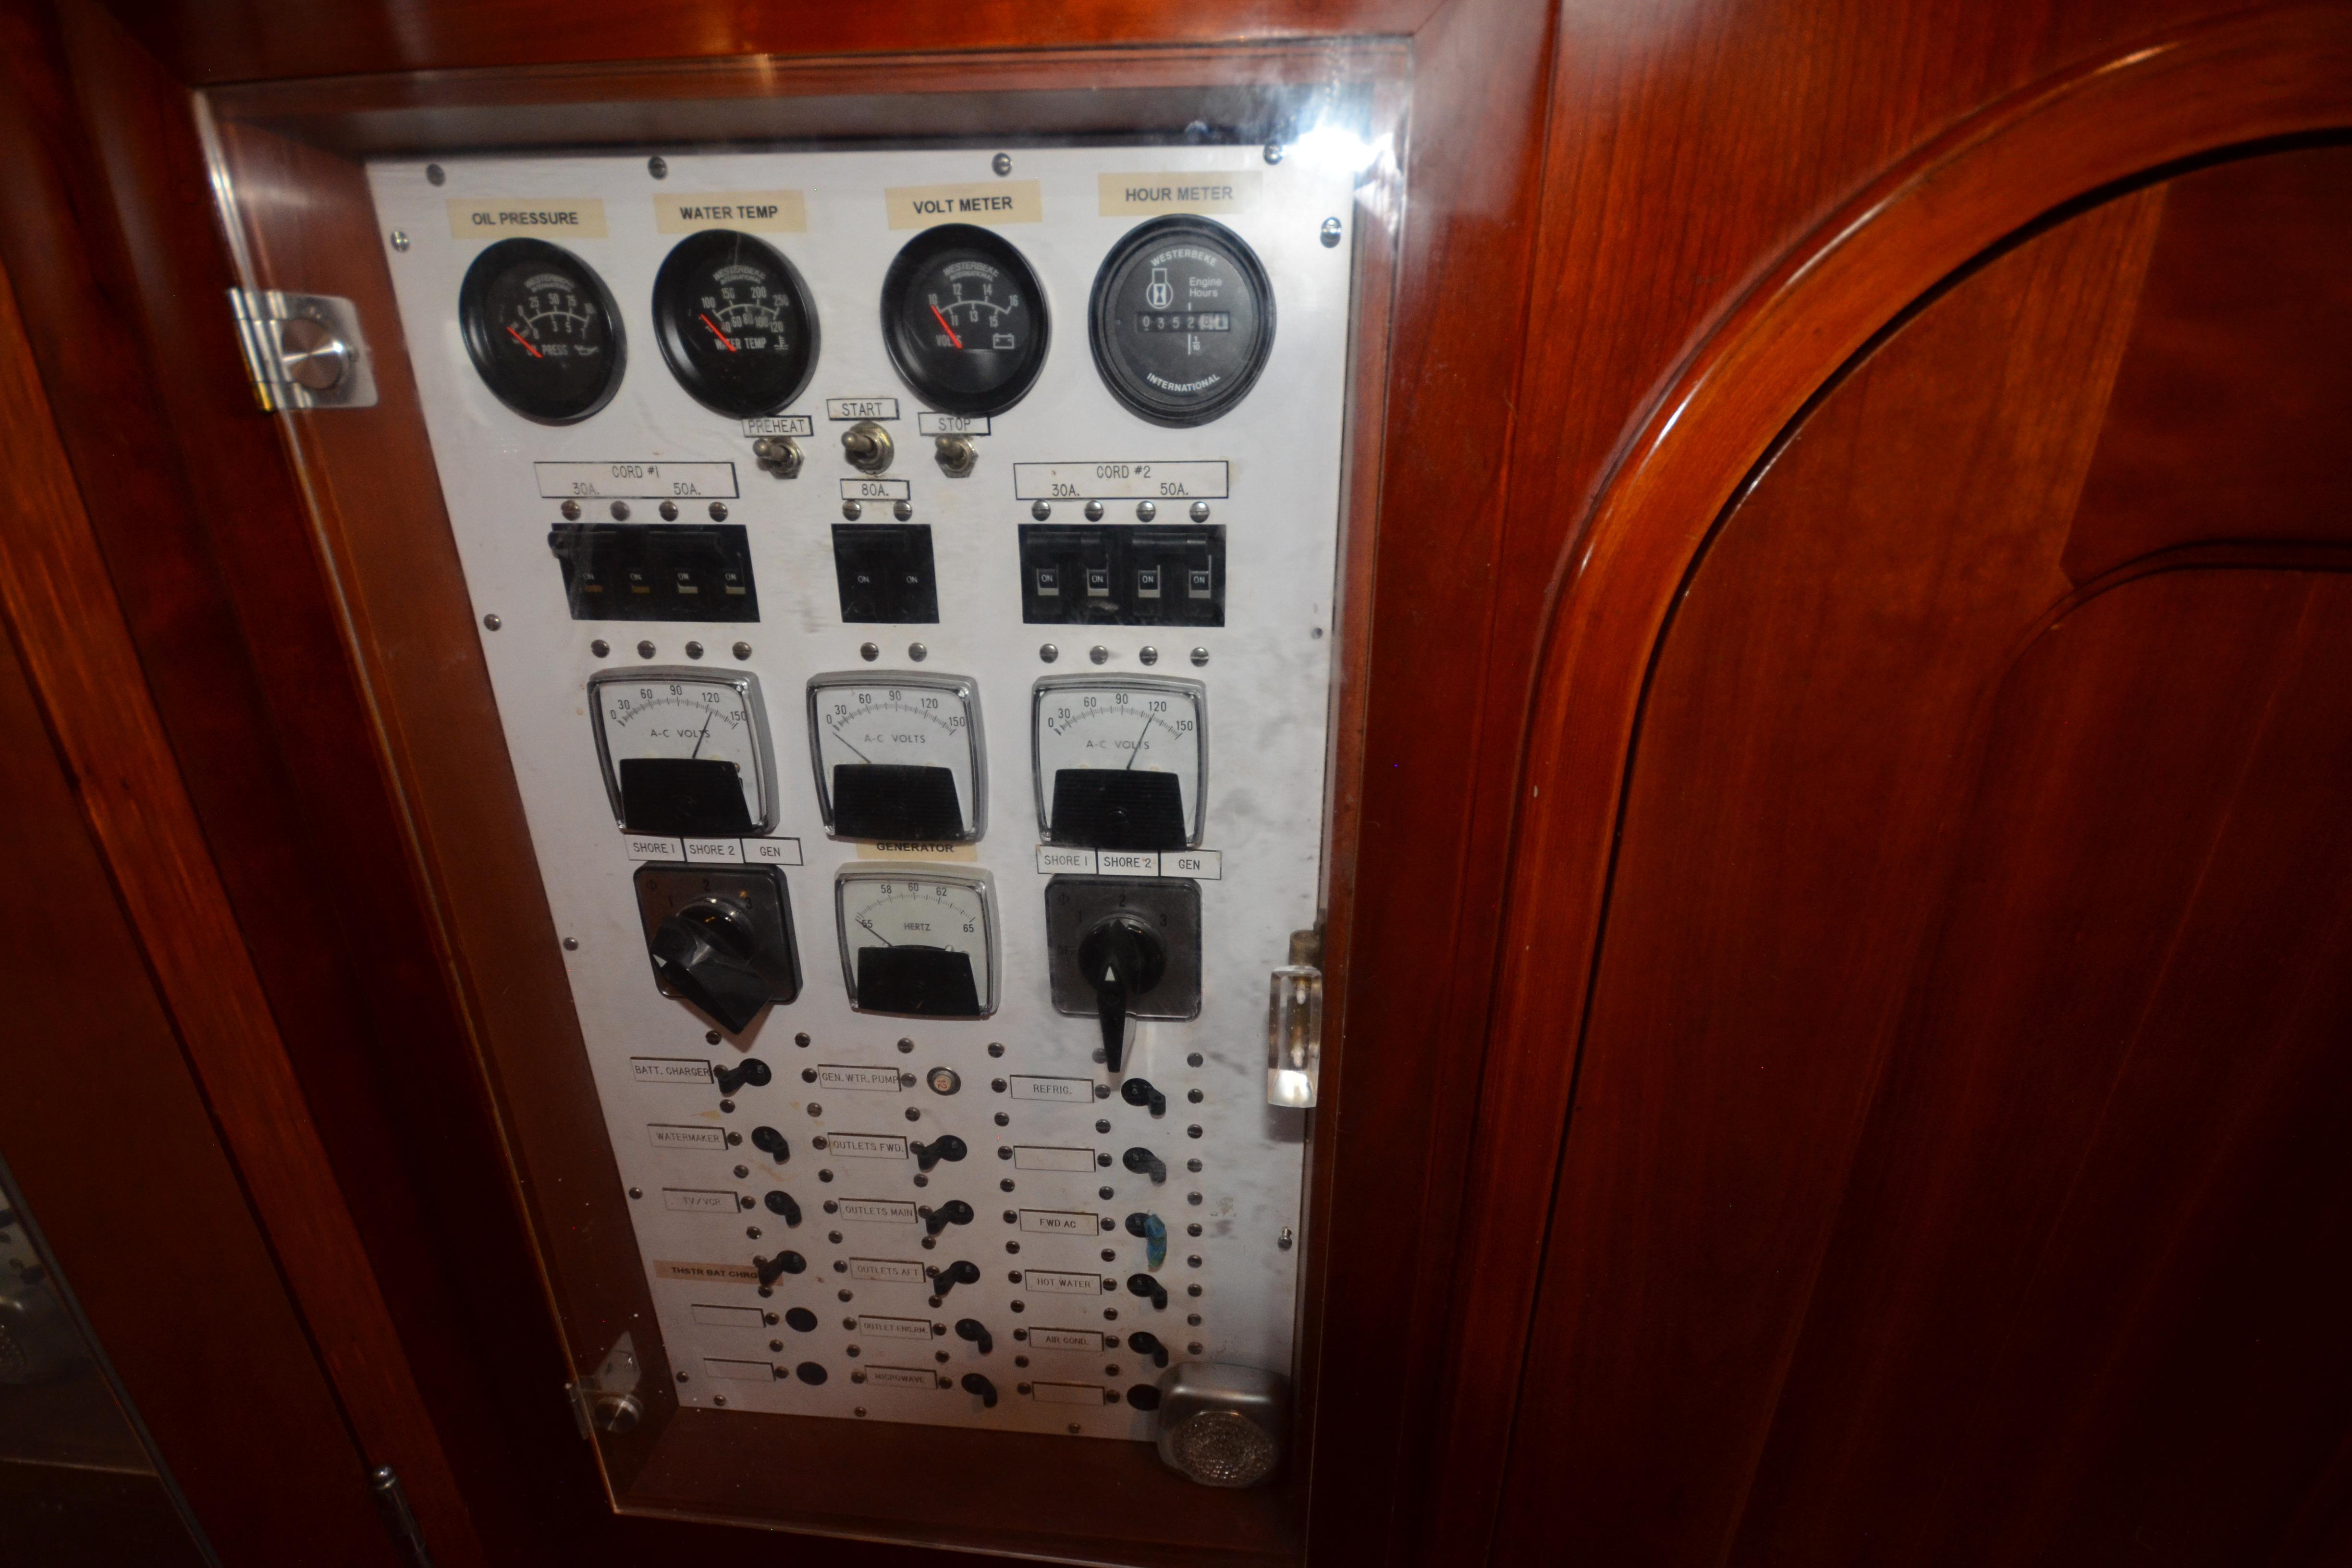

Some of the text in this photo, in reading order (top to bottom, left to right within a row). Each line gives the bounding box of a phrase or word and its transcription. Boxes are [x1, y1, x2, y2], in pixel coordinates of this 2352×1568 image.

[1125, 185, 1233, 202] HOUR METER
[913, 196, 1013, 215] VOLT METER
[680, 205, 778, 220] WATER TEMP
[472, 212, 578, 225] OIL PRESSURE
[1151, 249, 1217, 267] WESTERBEKE
[713, 265, 766, 281] WESTERBEKE
[943, 261, 999, 277] WESTERBEKE
[1189, 277, 1223, 287] Engine
[722, 288, 735, 299] 150
[751, 286, 767, 298] 200
[953, 283, 962, 295] 12
[983, 283, 992, 295] 14
[1189, 288, 1218, 297] Hours
[529, 296, 539, 308] 25
[548, 293, 560, 305] 50
[566, 295, 576, 306] 75
[701, 296, 716, 308] 100
[772, 294, 789, 306] 250
[928, 294, 937, 305] 10
[1010, 294, 1018, 306] 16
[951, 315, 958, 326] 11
[969, 310, 978, 322] 13
[989, 316, 998, 327] 15
[731, 316, 742, 328] 60
[770, 321, 784, 332] 120
[744, 337, 766, 349] TEMP
[541, 344, 568, 355] PRESS
[1147, 373, 1220, 392] INTERNATIONAL
[842, 403, 883, 416] START
[748, 419, 805, 432] PREHEAT
[938, 417, 971, 431] STOP
[612, 466, 660, 478] CORD #1
[1097, 466, 1151, 478] CORD #2
[572, 482, 701, 495] 30A. 50A.
[862, 484, 889, 496] 80A.
[1052, 483, 1189, 497] 30A. 50A.
[640, 689, 652, 699] 60
[670, 685, 682, 696] 90
[889, 690, 901, 701] 90
[702, 693, 720, 703] 120
[859, 694, 871, 704] 60
[921, 698, 938, 709] 120
[1084, 697, 1096, 707] 60
[1115, 694, 1128, 704] 90
[618, 699, 630, 710] 30
[835, 705, 847, 715] 30
[1149, 701, 1167, 712] 120
[610, 710, 617, 720] 0
[730, 710, 747, 721] 150
[826, 714, 832, 724] 0
[1058, 708, 1070, 719] 30
[949, 717, 966, 727] 150
[1048, 717, 1054, 728] 0
[1176, 721, 1193, 731] 150
[650, 729, 710, 738] A-C VOLTS
[864, 735, 926, 743] A-C VOLTS
[1086, 740, 1150, 750] A-C VOLTS
[633, 843, 668, 853] SHORE
[690, 844, 735, 855] SHORE 2
[760, 846, 781, 857] GEN
[876, 842, 954, 853] GENERATOR
[1044, 855, 1080, 866] SHORE
[1104, 857, 1152, 868] SHORE 2
[1178, 859, 1200, 870] GEN
[881, 884, 892, 894] 58
[908, 882, 919, 892] 60
[936, 887, 947, 897] 62
[904, 923, 931, 931] HERTZ
[963, 924, 974, 933] 65
[635, 1066, 710, 1077] BATT. CHARGER
[822, 1072, 899, 1084] GEN. WTR. PUMP
[937, 1079, 948, 1090] 12
[1033, 1084, 1072, 1095] REFRIG.
[656, 1132, 720, 1143] WATERMAKER
[833, 1140, 904, 1152] OUTLETS FWD.
[845, 1206, 913, 1217] OUTLETS MAIN
[1040, 1218, 1061, 1227] FWD
[671, 1266, 705, 1276] THSTR
[706, 1269, 725, 1277] BAT
[858, 1265, 919, 1276] OUTLETS AFT
[1059, 1280, 1091, 1289] WATER
[863, 1323, 894, 1332] OUTLET
[875, 1373, 925, 1384] MICROWAVE
